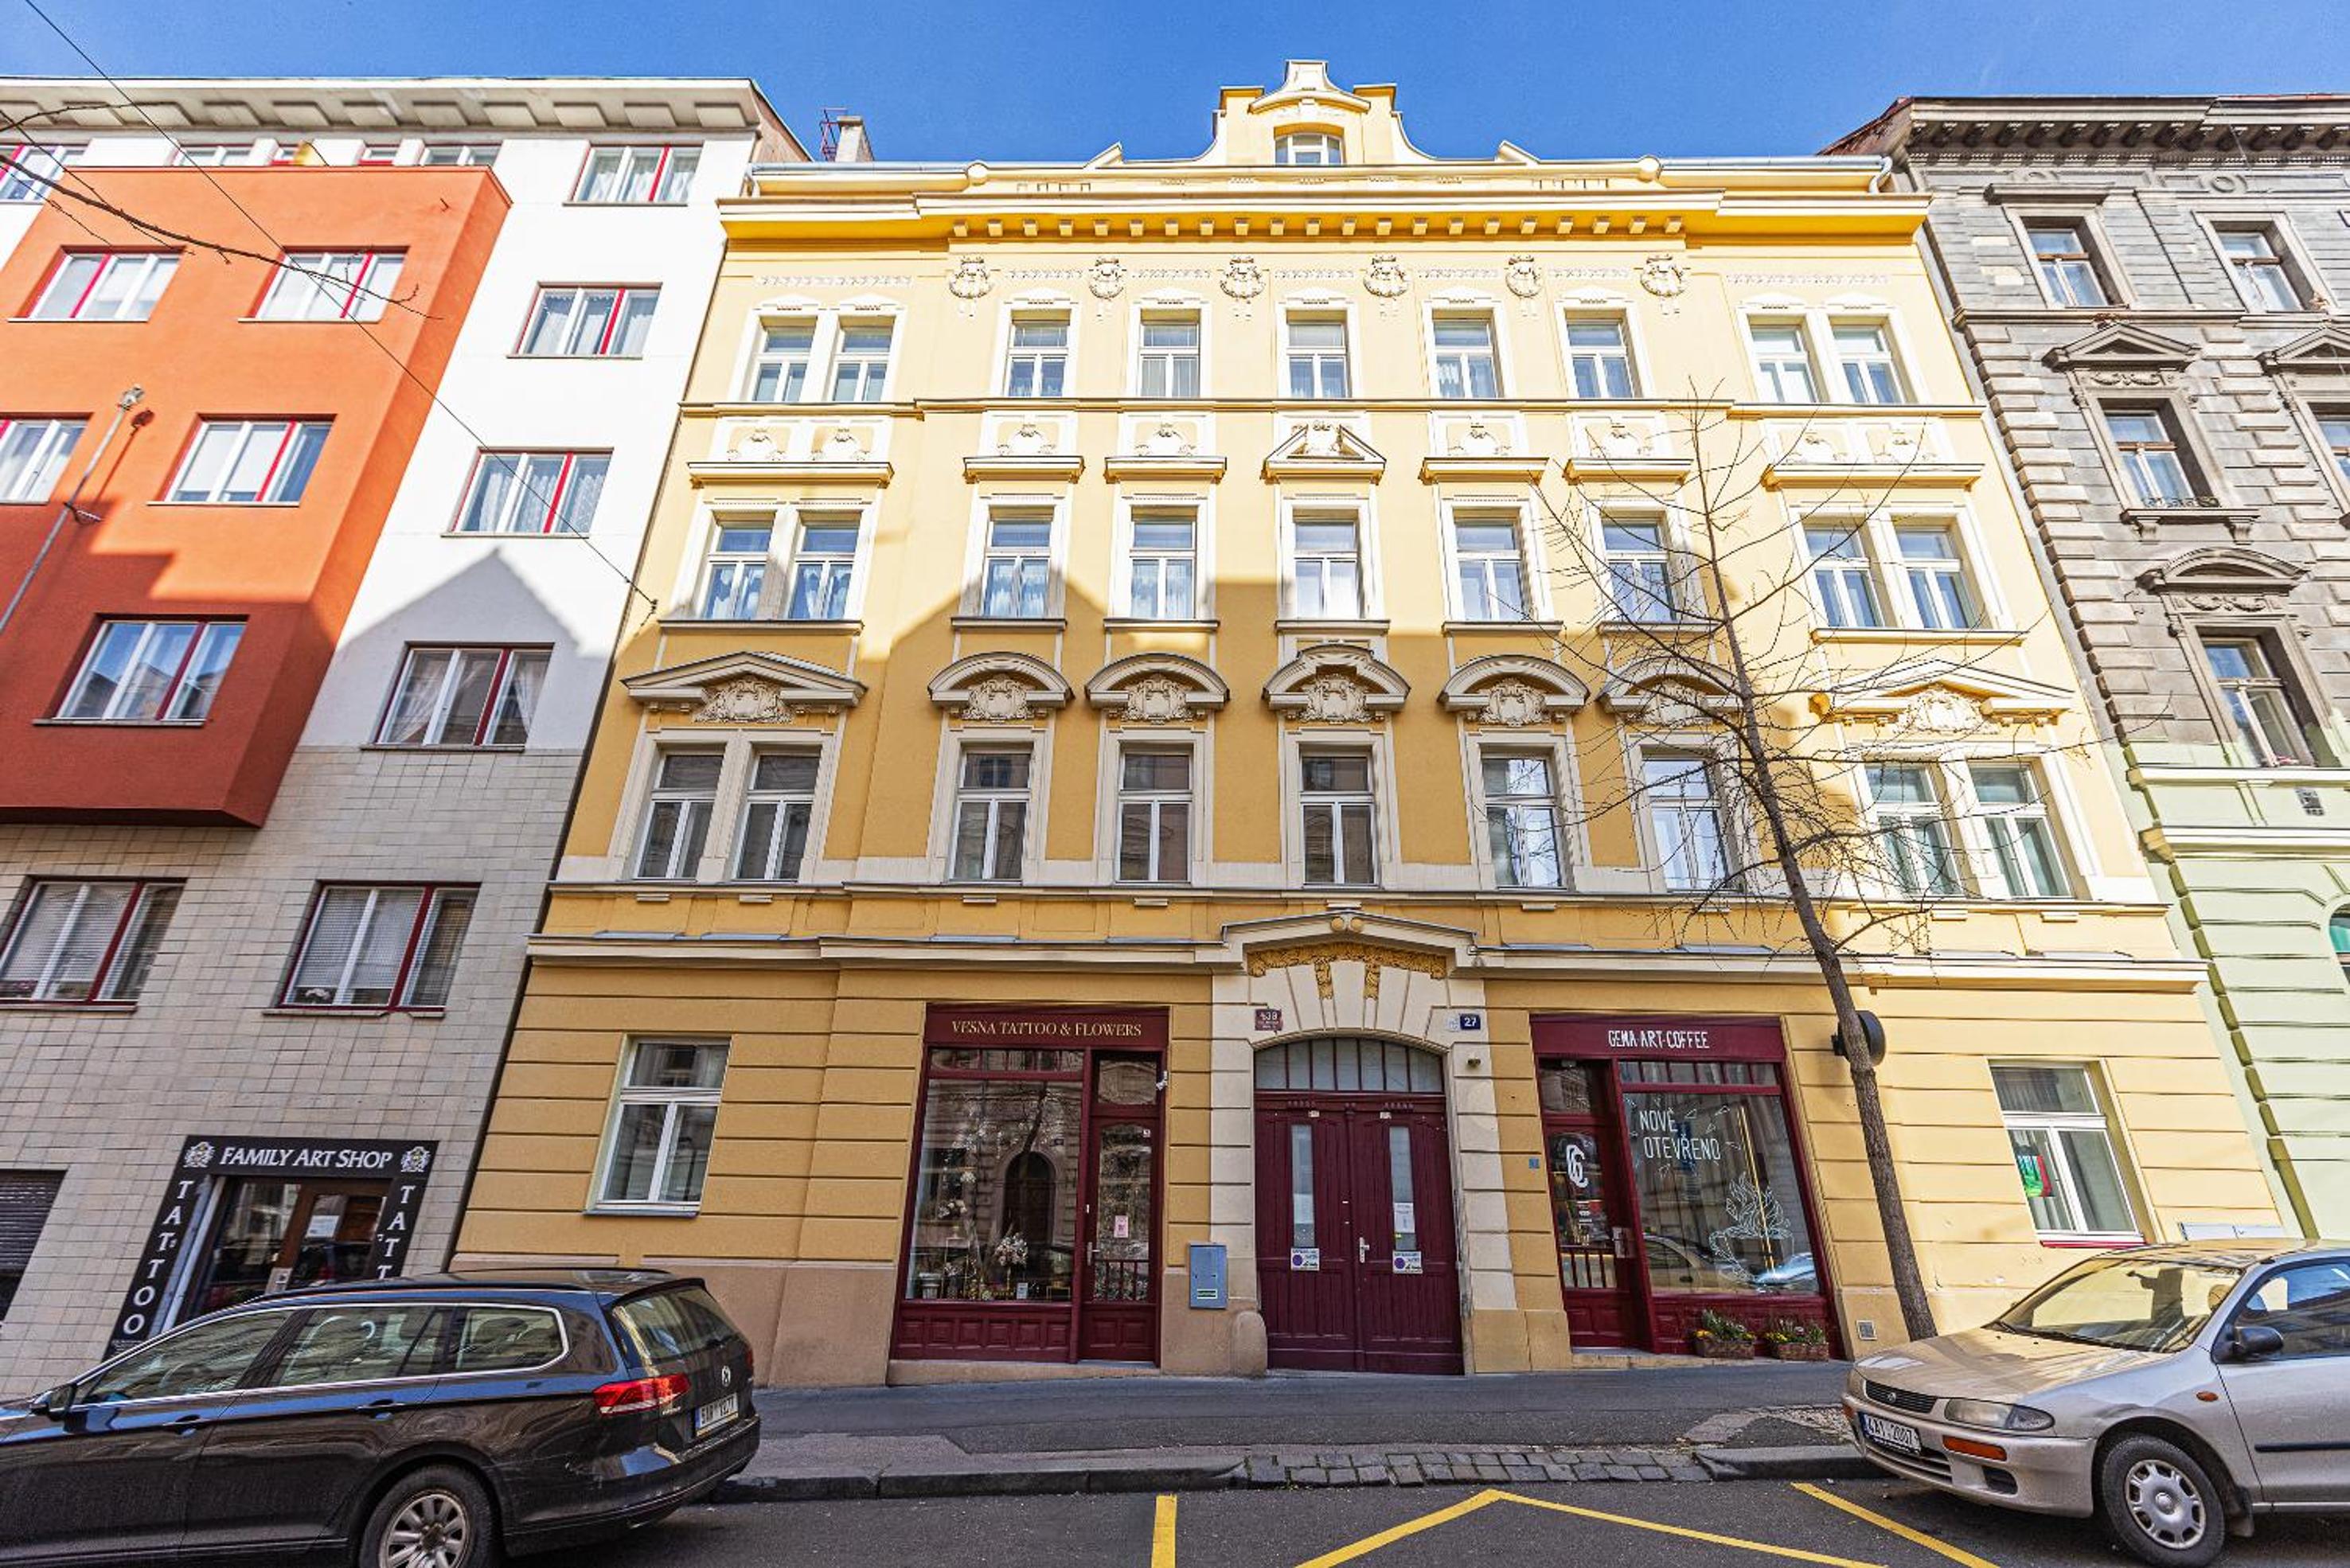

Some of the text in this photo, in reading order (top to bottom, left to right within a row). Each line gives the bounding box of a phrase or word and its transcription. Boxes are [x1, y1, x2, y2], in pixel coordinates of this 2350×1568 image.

[952, 1020, 1142, 1036] VESNA TATTOO & FLOWERS
[1464, 1017, 1477, 1027] 27
[1641, 1030, 1662, 1048] ART
[1666, 1030, 1710, 1049] COFFEE
[1643, 1133, 1721, 1160] OTEVŘENO
[220, 1147, 392, 1168] FAMILY ART SHOP
[123, 1180, 194, 1334] TATTOO
